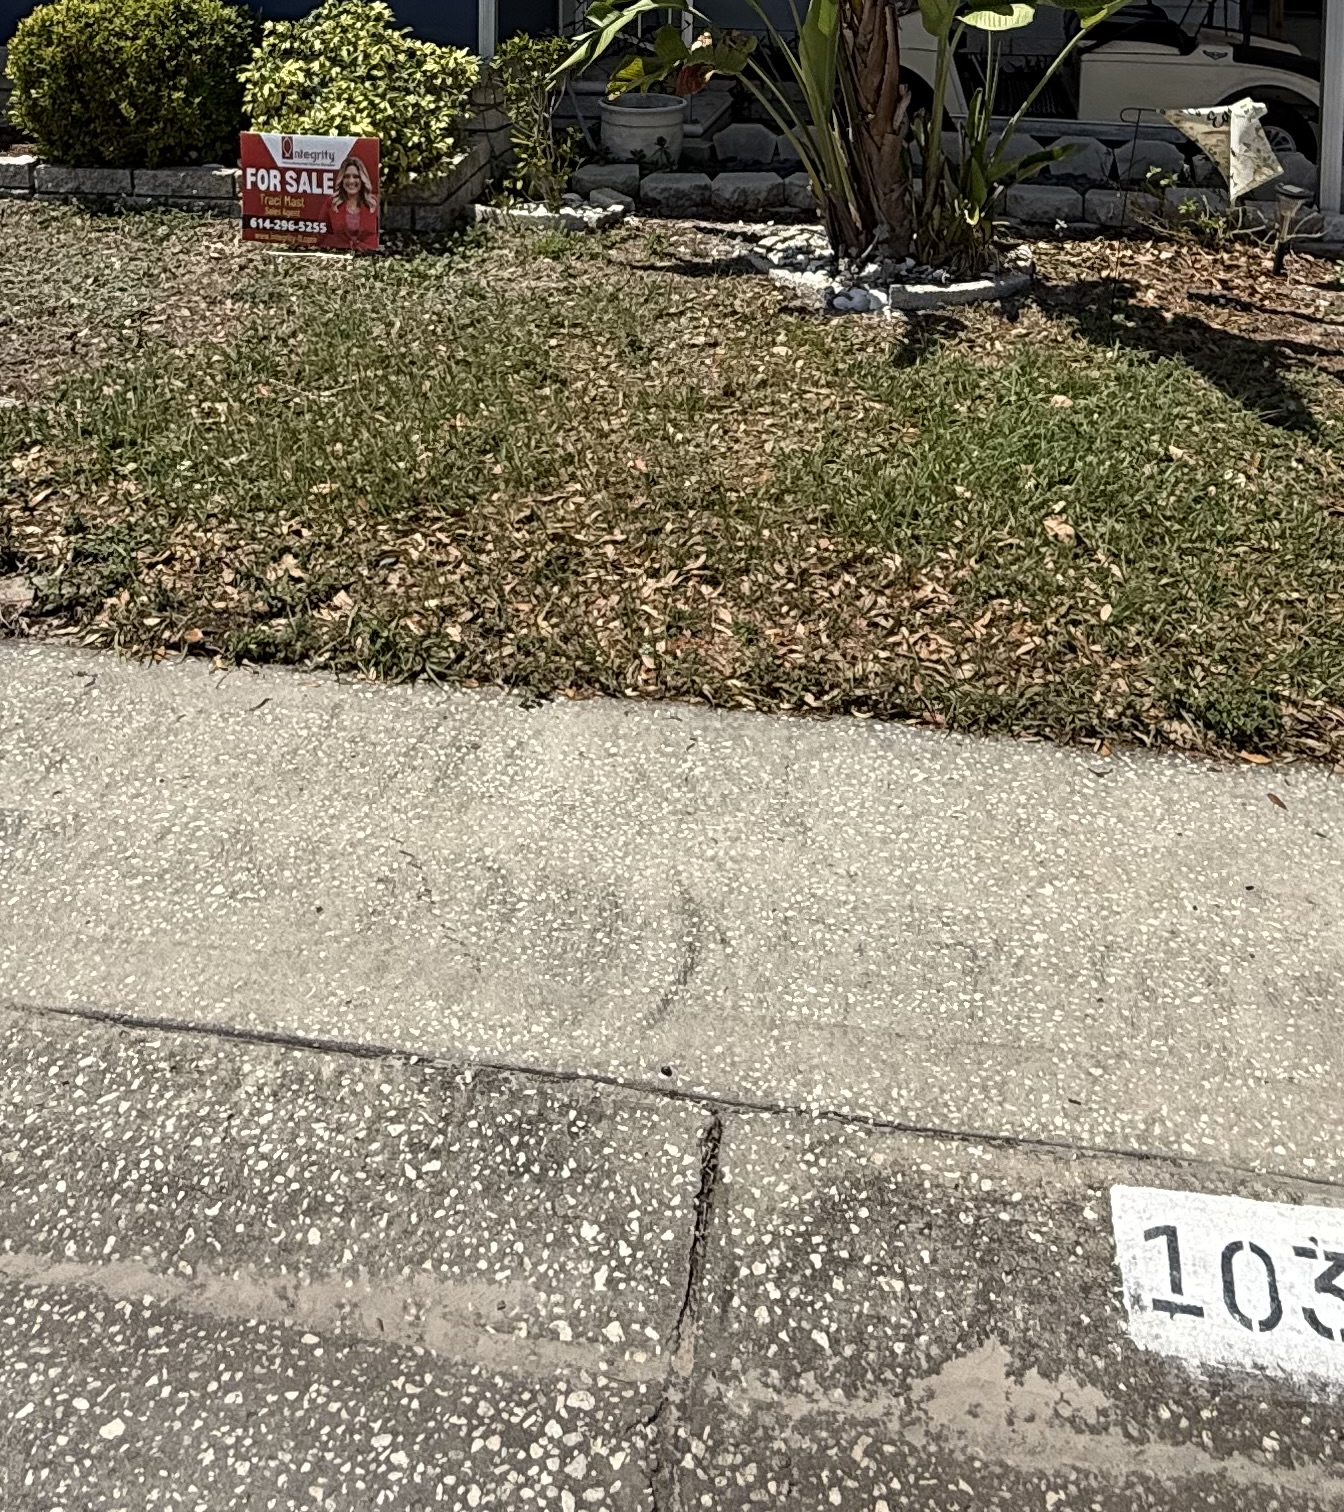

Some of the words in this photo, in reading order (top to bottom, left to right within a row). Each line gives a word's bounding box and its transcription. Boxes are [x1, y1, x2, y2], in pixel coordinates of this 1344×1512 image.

[246, 168, 281, 192] FOR
[285, 170, 334, 194] SALE
[250, 218, 327, 233] 614-296-5255
